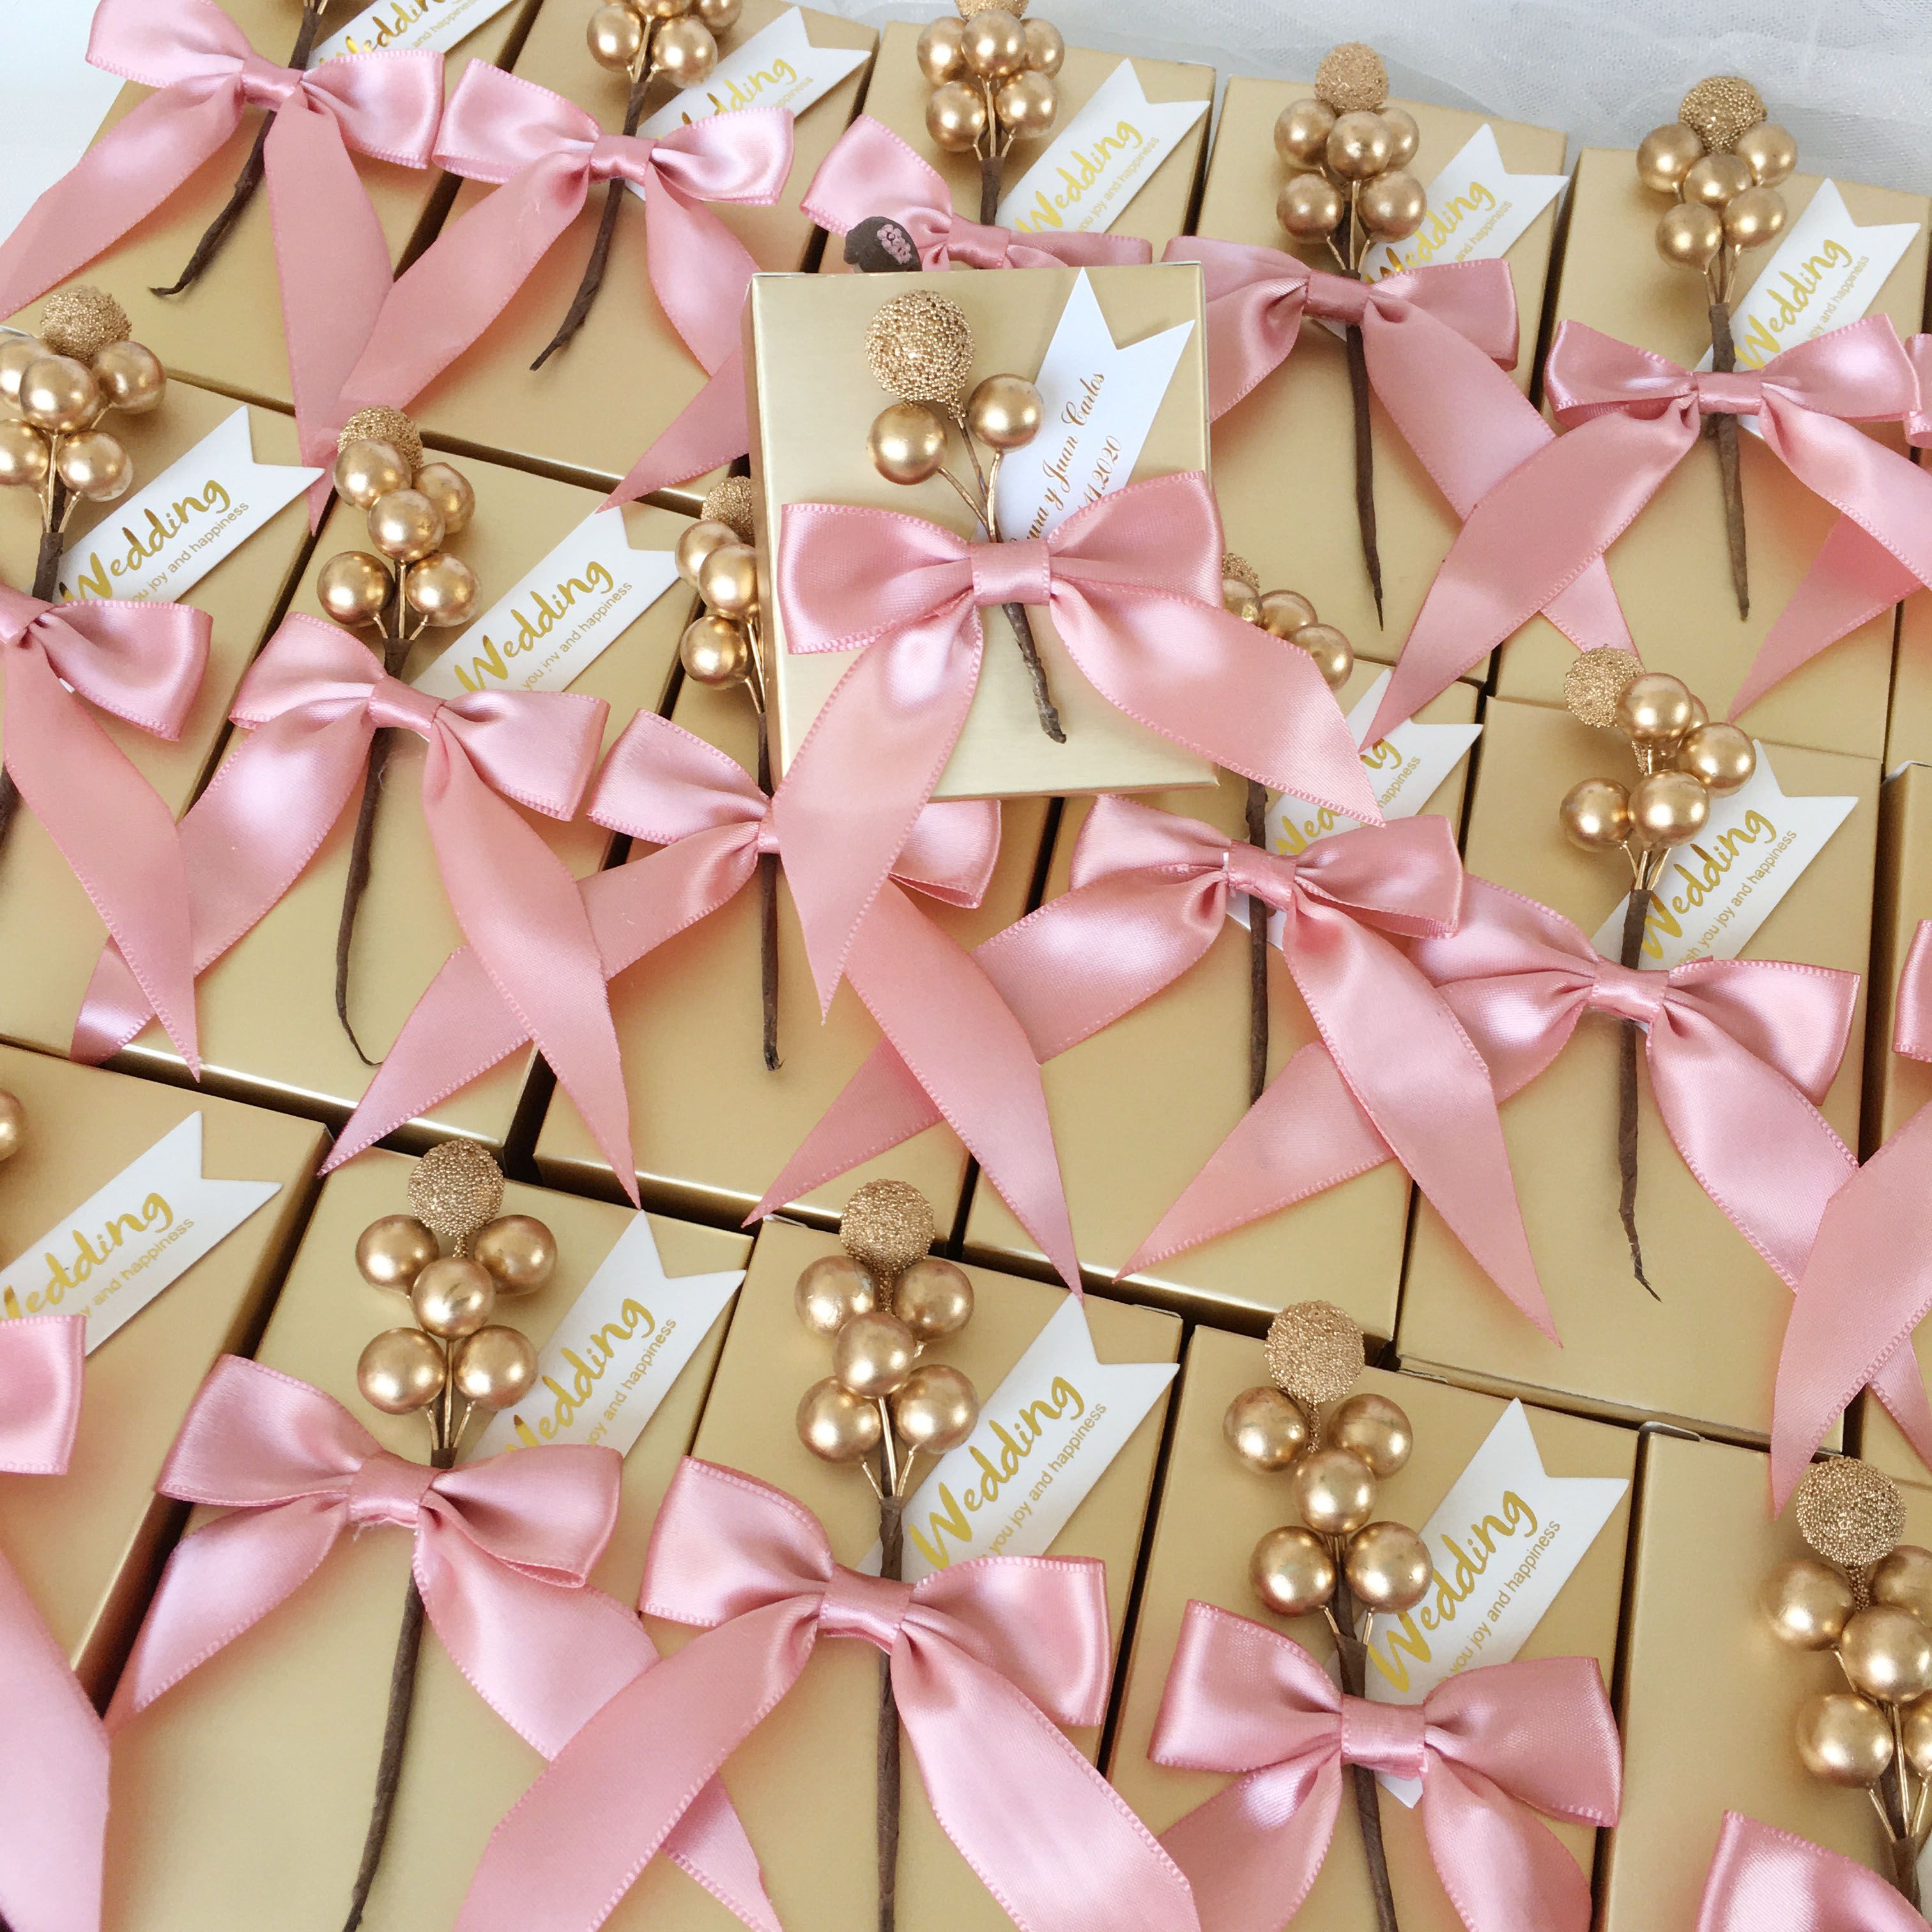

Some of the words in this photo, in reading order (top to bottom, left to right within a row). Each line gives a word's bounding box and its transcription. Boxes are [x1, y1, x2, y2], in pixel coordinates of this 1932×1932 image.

[1015, 121, 1143, 233] Wedding
[1103, 181, 1123, 201] and
[1116, 137, 1160, 182] happiness
[1469, 201, 1514, 245] happiness
[1734, 239, 1853, 369] Wedding
[1820, 303, 1837, 323] and
[1835, 255, 1871, 304] happiness
[1061, 373, 1105, 427] Carlos
[1043, 436, 1079, 493] Juan
[1045, 487, 1064, 512] y
[59, 480, 231, 601] Wedding
[147, 572, 168, 592] joy
[167, 551, 192, 573] and
[189, 502, 250, 553] happiness
[454, 561, 614, 693] Wedding
[522, 669, 544, 691] you
[561, 631, 581, 652] and
[578, 582, 633, 632] happiness
[1698, 924, 1721, 949] you
[1713, 905, 1736, 928] joy
[1731, 883, 1752, 907] and
[1746, 829, 1798, 885] happiness
[93, 1278, 123, 1306] and
[120, 1218, 194, 1280] happiness
[603, 1390, 627, 1421] and
[620, 1319, 677, 1391] happiness
[910, 1376, 1084, 1570] Wedding
[989, 1525, 1015, 1556] you
[1008, 1501, 1033, 1528] joy
[1029, 1471, 1054, 1501] and
[1048, 1402, 1107, 1473] happiness
[1367, 1491, 1538, 1693] Wedding
[1450, 1646, 1474, 1675] you
[1467, 1621, 1492, 1650] joy
[1487, 1590, 1511, 1623] and
[1504, 1521, 1561, 1593] happiness
